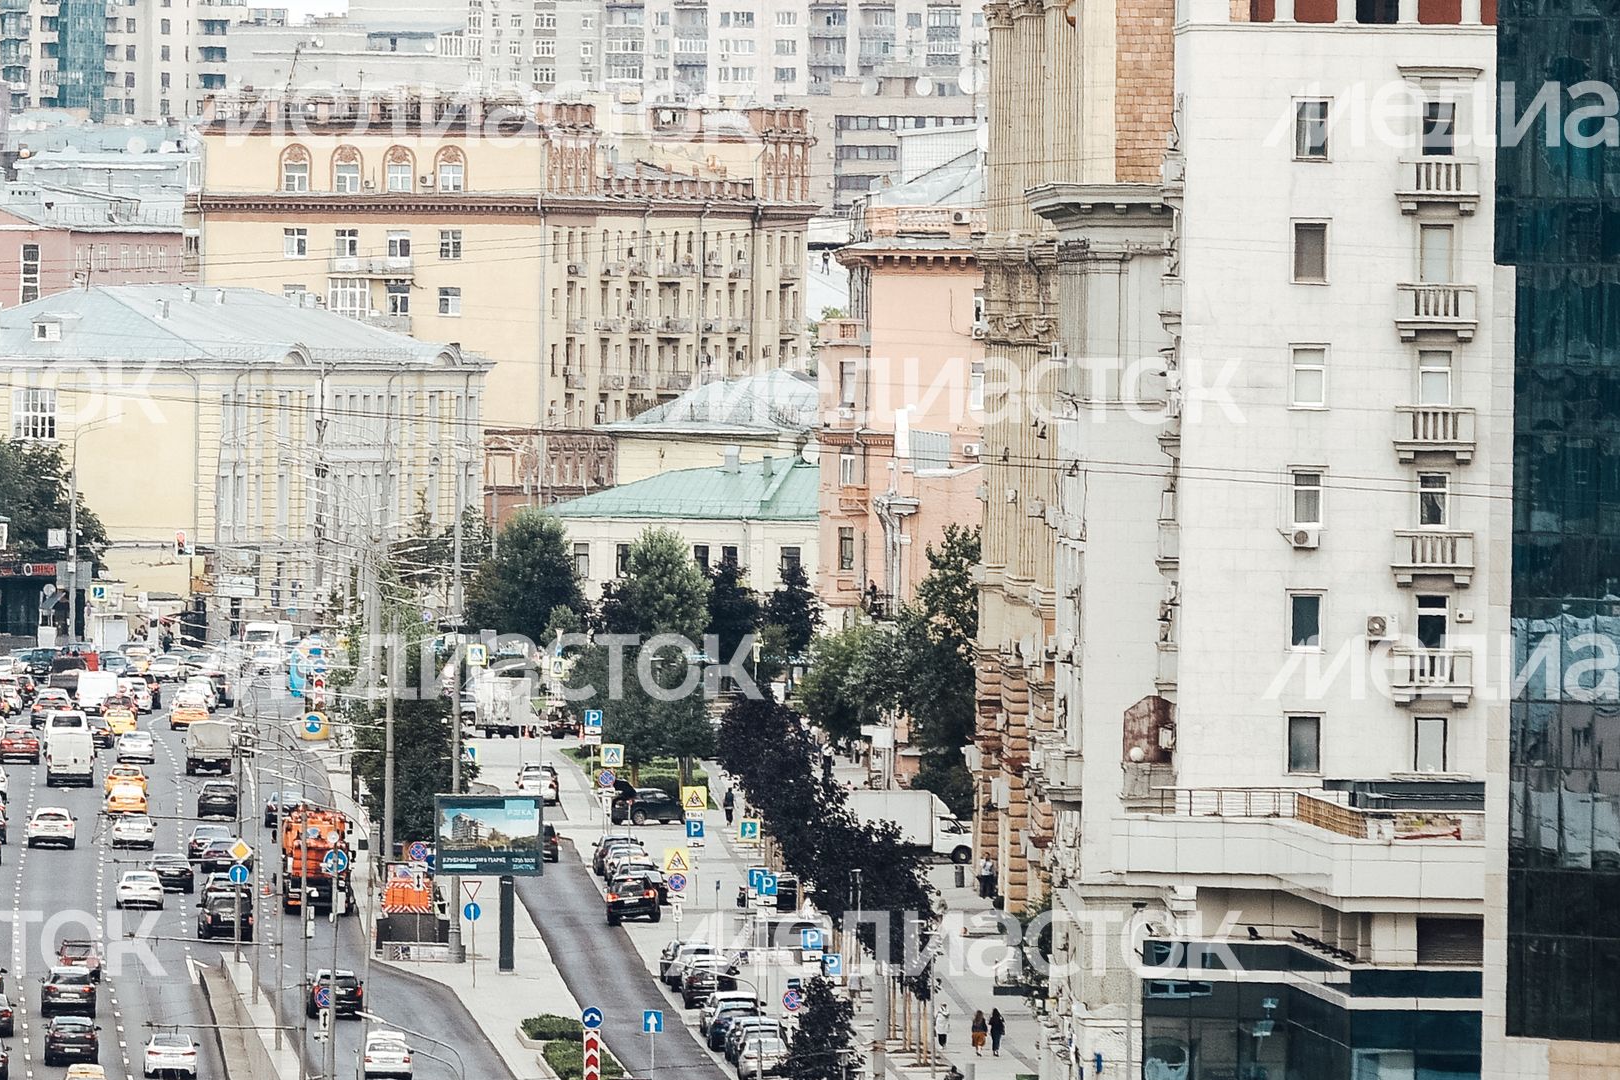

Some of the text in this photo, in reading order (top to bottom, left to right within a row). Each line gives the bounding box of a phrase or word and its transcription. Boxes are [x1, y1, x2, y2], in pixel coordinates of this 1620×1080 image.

[690, 821, 701, 836] P
[762, 877, 774, 893] P
[806, 930, 818, 948] P
